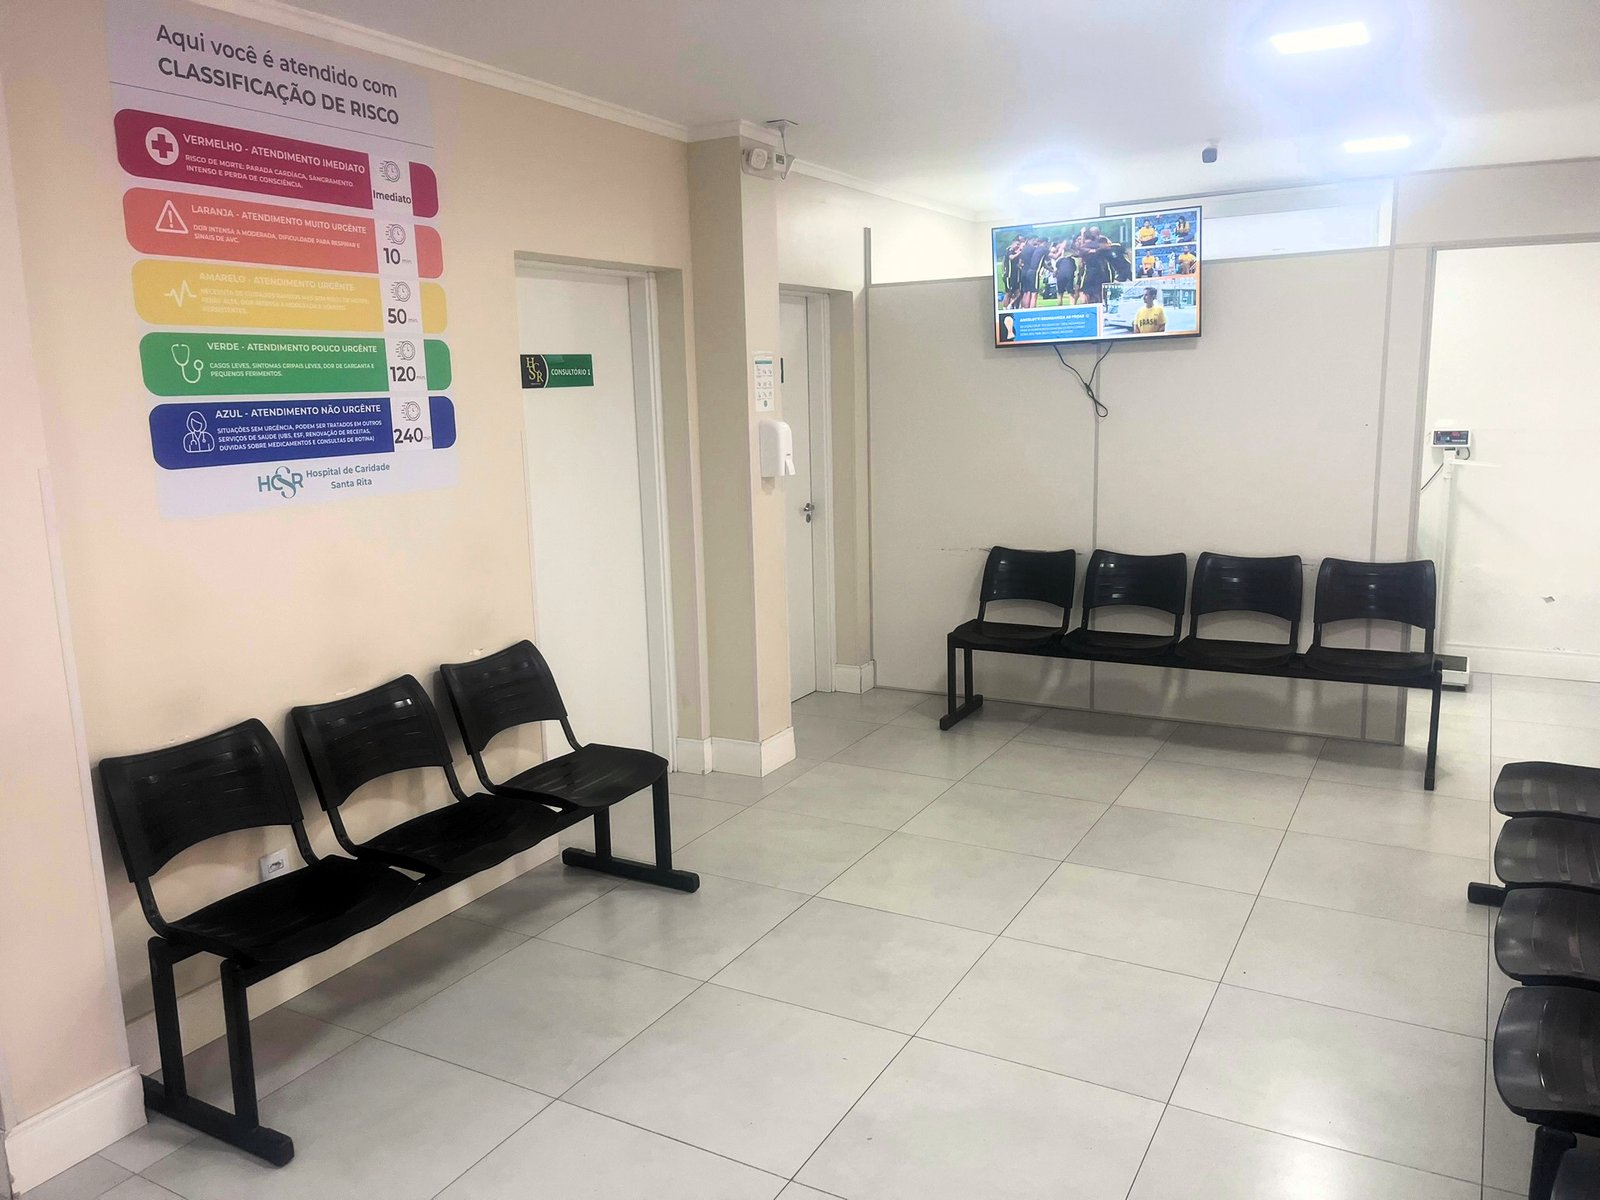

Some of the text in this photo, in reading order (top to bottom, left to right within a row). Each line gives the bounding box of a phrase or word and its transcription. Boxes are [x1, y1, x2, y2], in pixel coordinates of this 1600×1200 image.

[156, 24, 398, 98] Aqui você é atendido com
[158, 57, 399, 124] CLASSIFICAÇÃO DE RISCO
[183, 134, 243, 152] VERMELHO
[251, 146, 320, 166] ATENDIMENTO
[322, 159, 365, 174] IMEDIATO
[185, 155, 206, 163] RISCO
[246, 164, 273, 174] PARADA
[309, 175, 353, 187] SANGRAMENTO
[187, 165, 217, 175] INTENSO
[225, 171, 247, 180] PERDA
[373, 190, 411, 204] Imediato
[191, 205, 234, 217] LARANJA
[241, 211, 302, 226] ATENDIMENTO
[304, 220, 330, 229] MUITO
[332, 223, 367, 234] URGÊNTE
[194, 233, 215, 241] SINAIS
[208, 226, 235, 235] INTENSA
[278, 234, 315, 243] DIFICULDADE
[331, 240, 356, 248] RESPIRAR
[383, 247, 401, 264] 10
[200, 272, 245, 283] AMARELO
[253, 276, 315, 288] ATENDIMENTO
[387, 308, 407, 324] 50
[207, 342, 239, 350] VERDE
[247, 343, 310, 351] ATENDIMENTO
[312, 344, 340, 352] POUCO
[342, 344, 377, 353] URGÊNTE
[390, 366, 416, 382] 120
[215, 409, 243, 418] AZUL
[251, 407, 319, 417] ATENDIMENTO
[321, 405, 341, 415] NÃO
[342, 403, 381, 413] URGÊNTE
[217, 426, 250, 434] SITUAÇÕES
[394, 427, 423, 444] 240
[218, 435, 248, 443] SERVIÇOS
[267, 439, 312, 448] MEDICAMENTOS
[306, 463, 390, 478] Hospital de Caridade
[331, 478, 372, 489] Santa Rita
